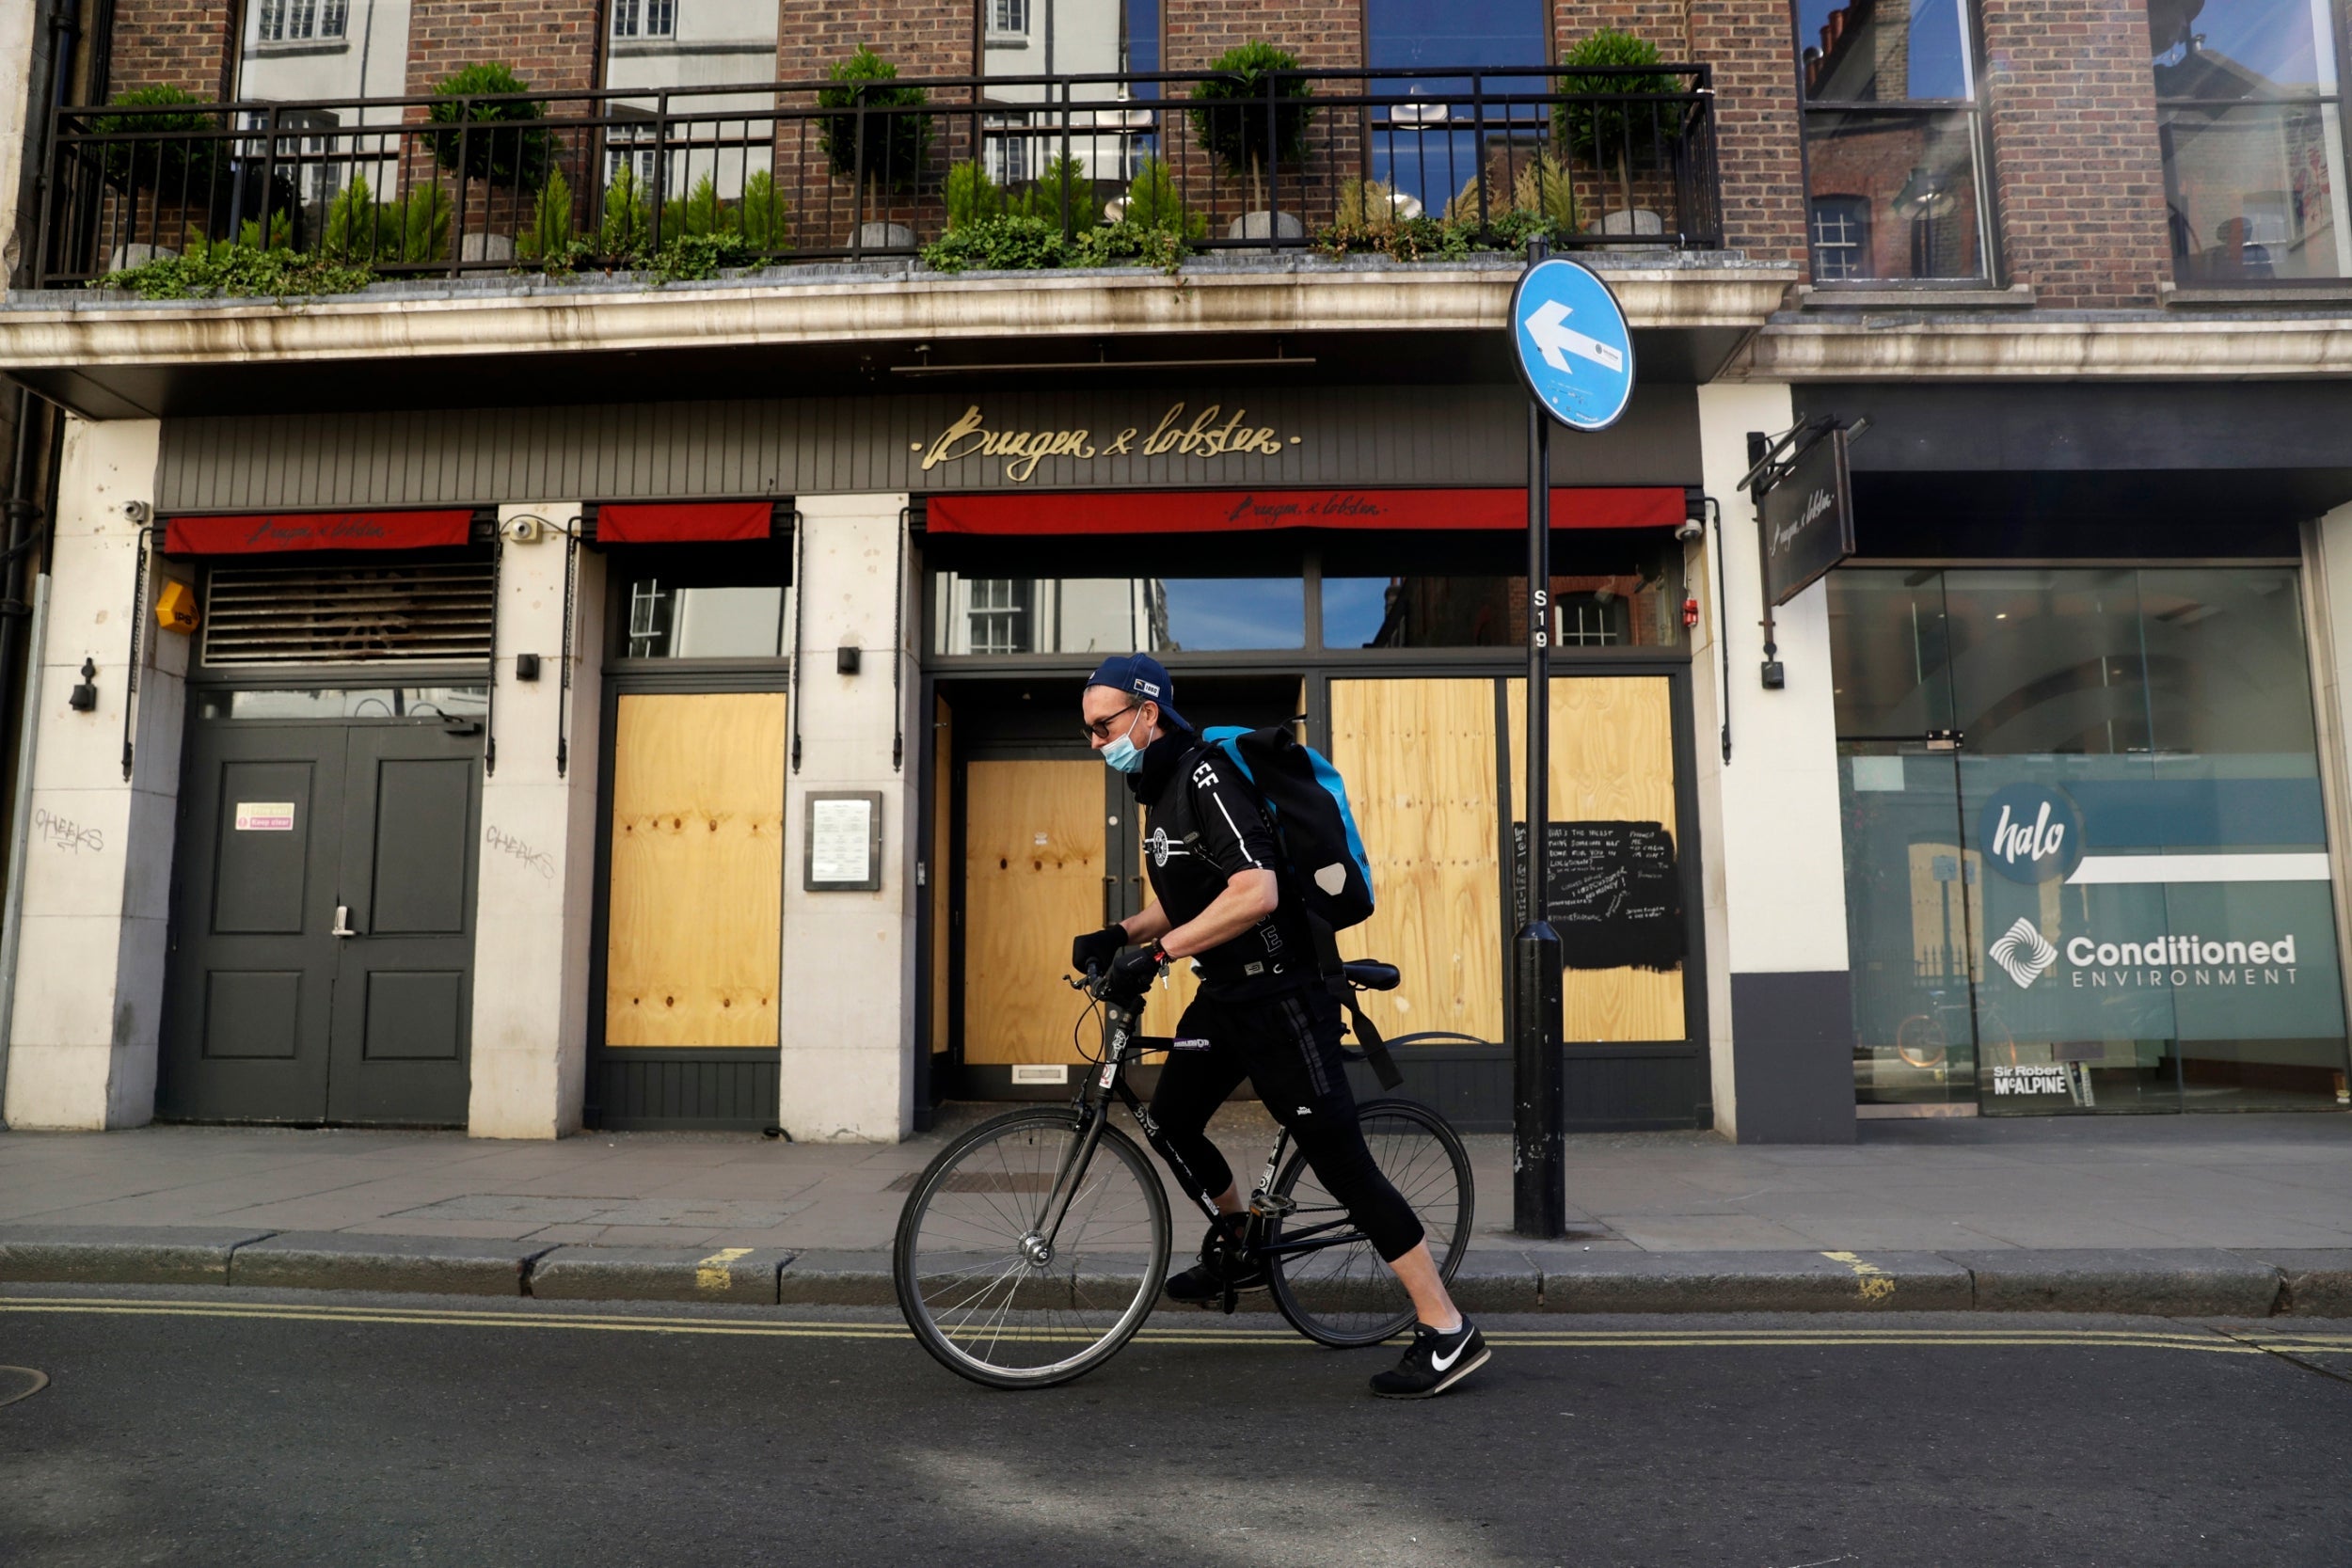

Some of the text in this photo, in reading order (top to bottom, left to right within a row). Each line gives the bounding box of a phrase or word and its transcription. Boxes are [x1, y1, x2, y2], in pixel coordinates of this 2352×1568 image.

[922, 405, 1095, 482] Burger
[1103, 427, 1137, 456] &
[1993, 800, 2065, 864] halo
[2067, 934, 2296, 967] Conditioned
[2073, 968, 2297, 988] ENVIRONMENT
[2014, 1065, 2064, 1076] Robert
